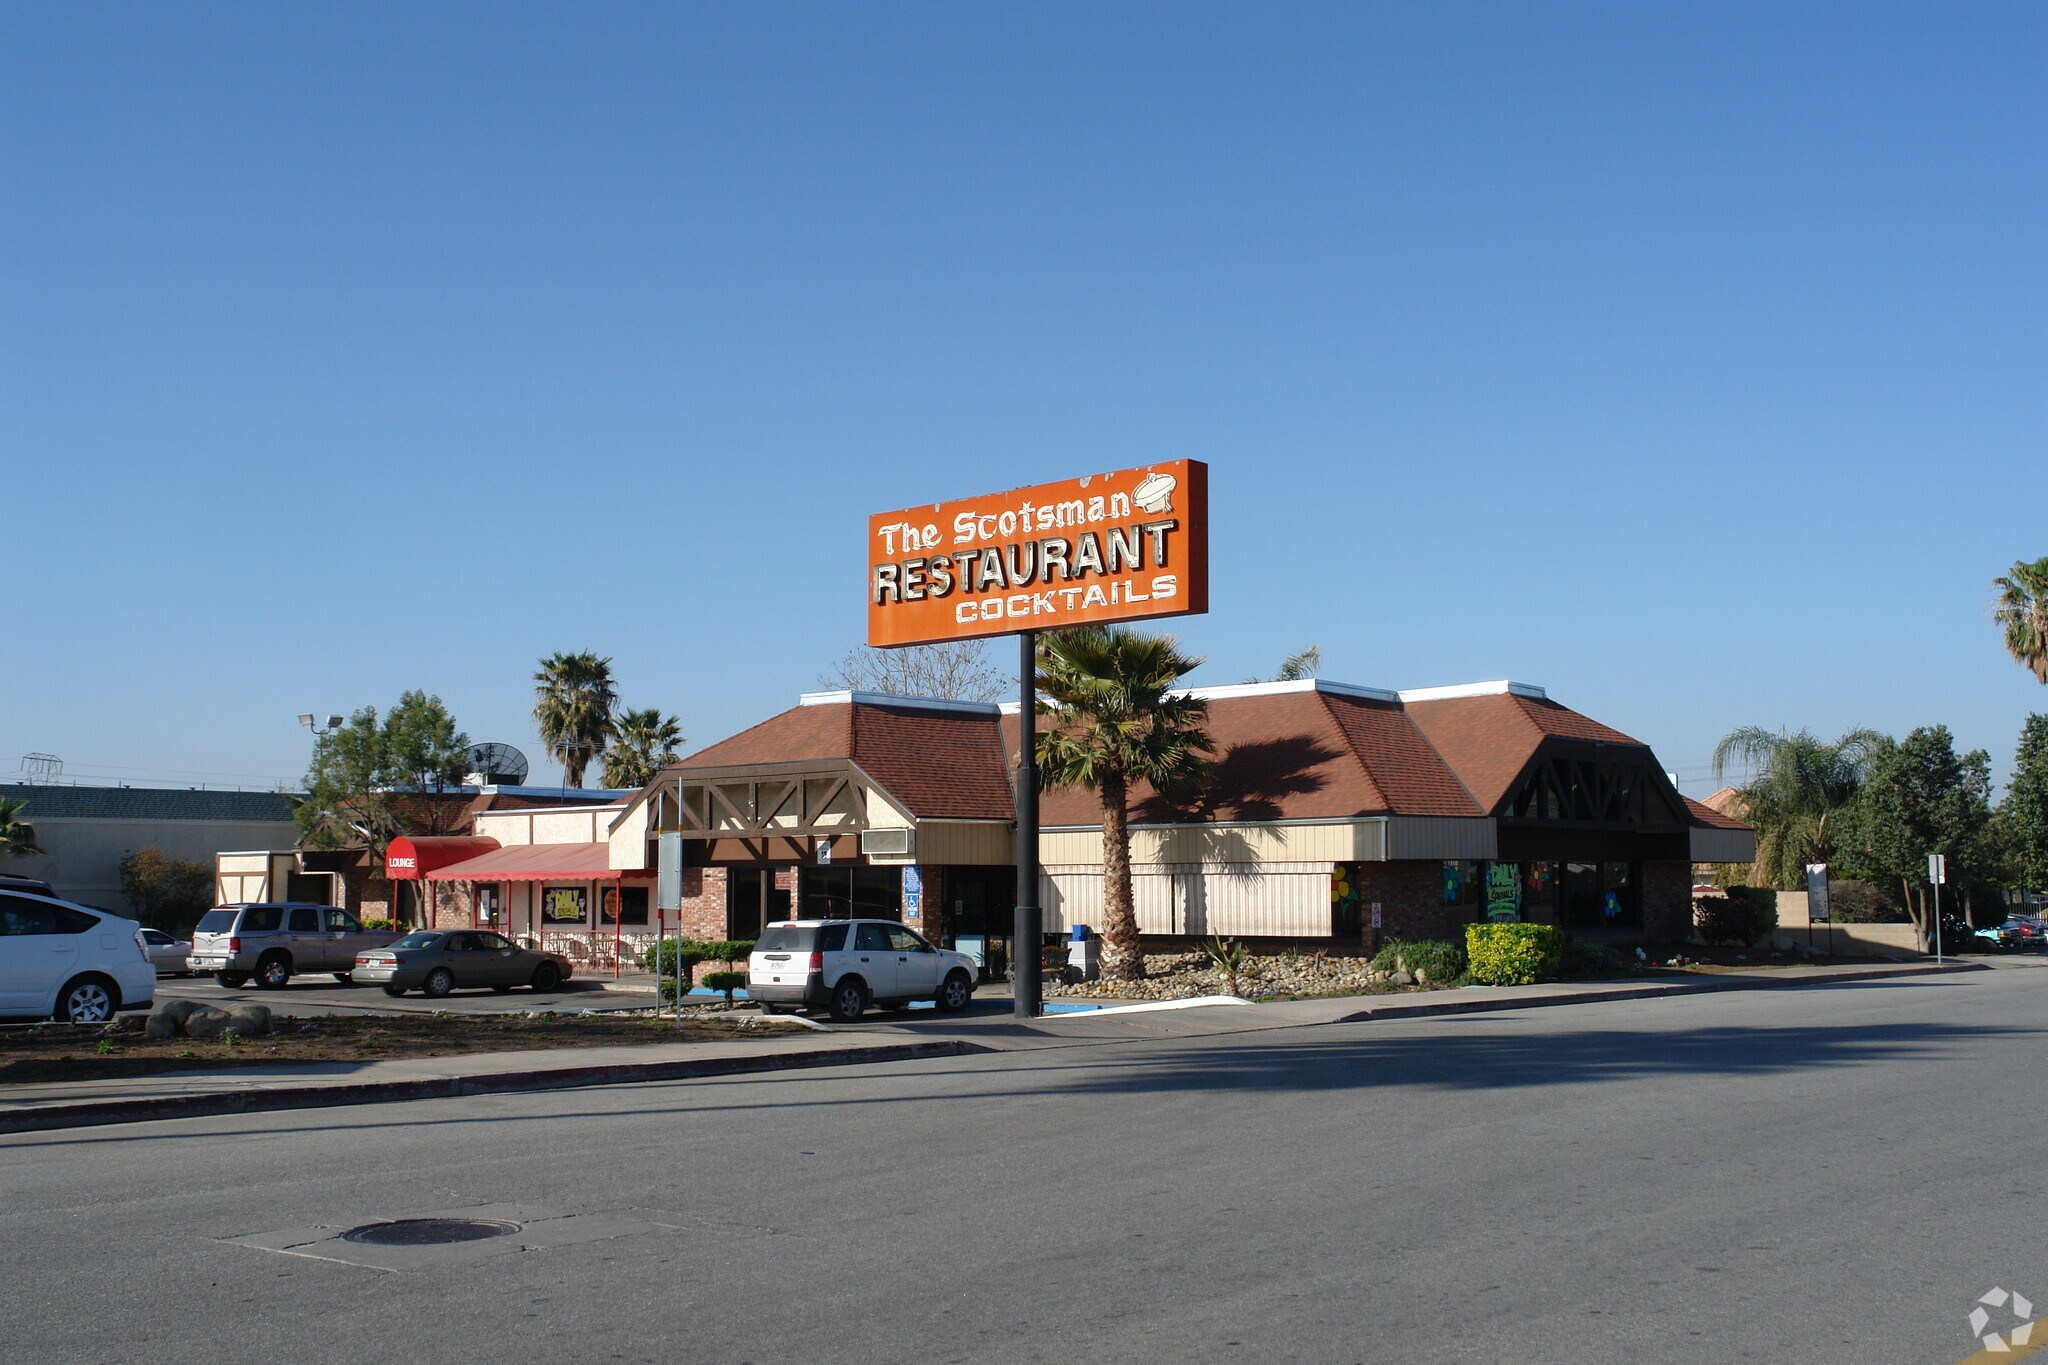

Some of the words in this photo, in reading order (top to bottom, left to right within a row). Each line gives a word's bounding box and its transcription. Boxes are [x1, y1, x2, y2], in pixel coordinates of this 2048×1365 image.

[877, 522, 943, 555] The
[953, 491, 1131, 545] Scotsman
[873, 519, 1176, 605] RESTAURANT
[955, 574, 1177, 624] COCKTAILS
[389, 857, 415, 868] LOUNGE
